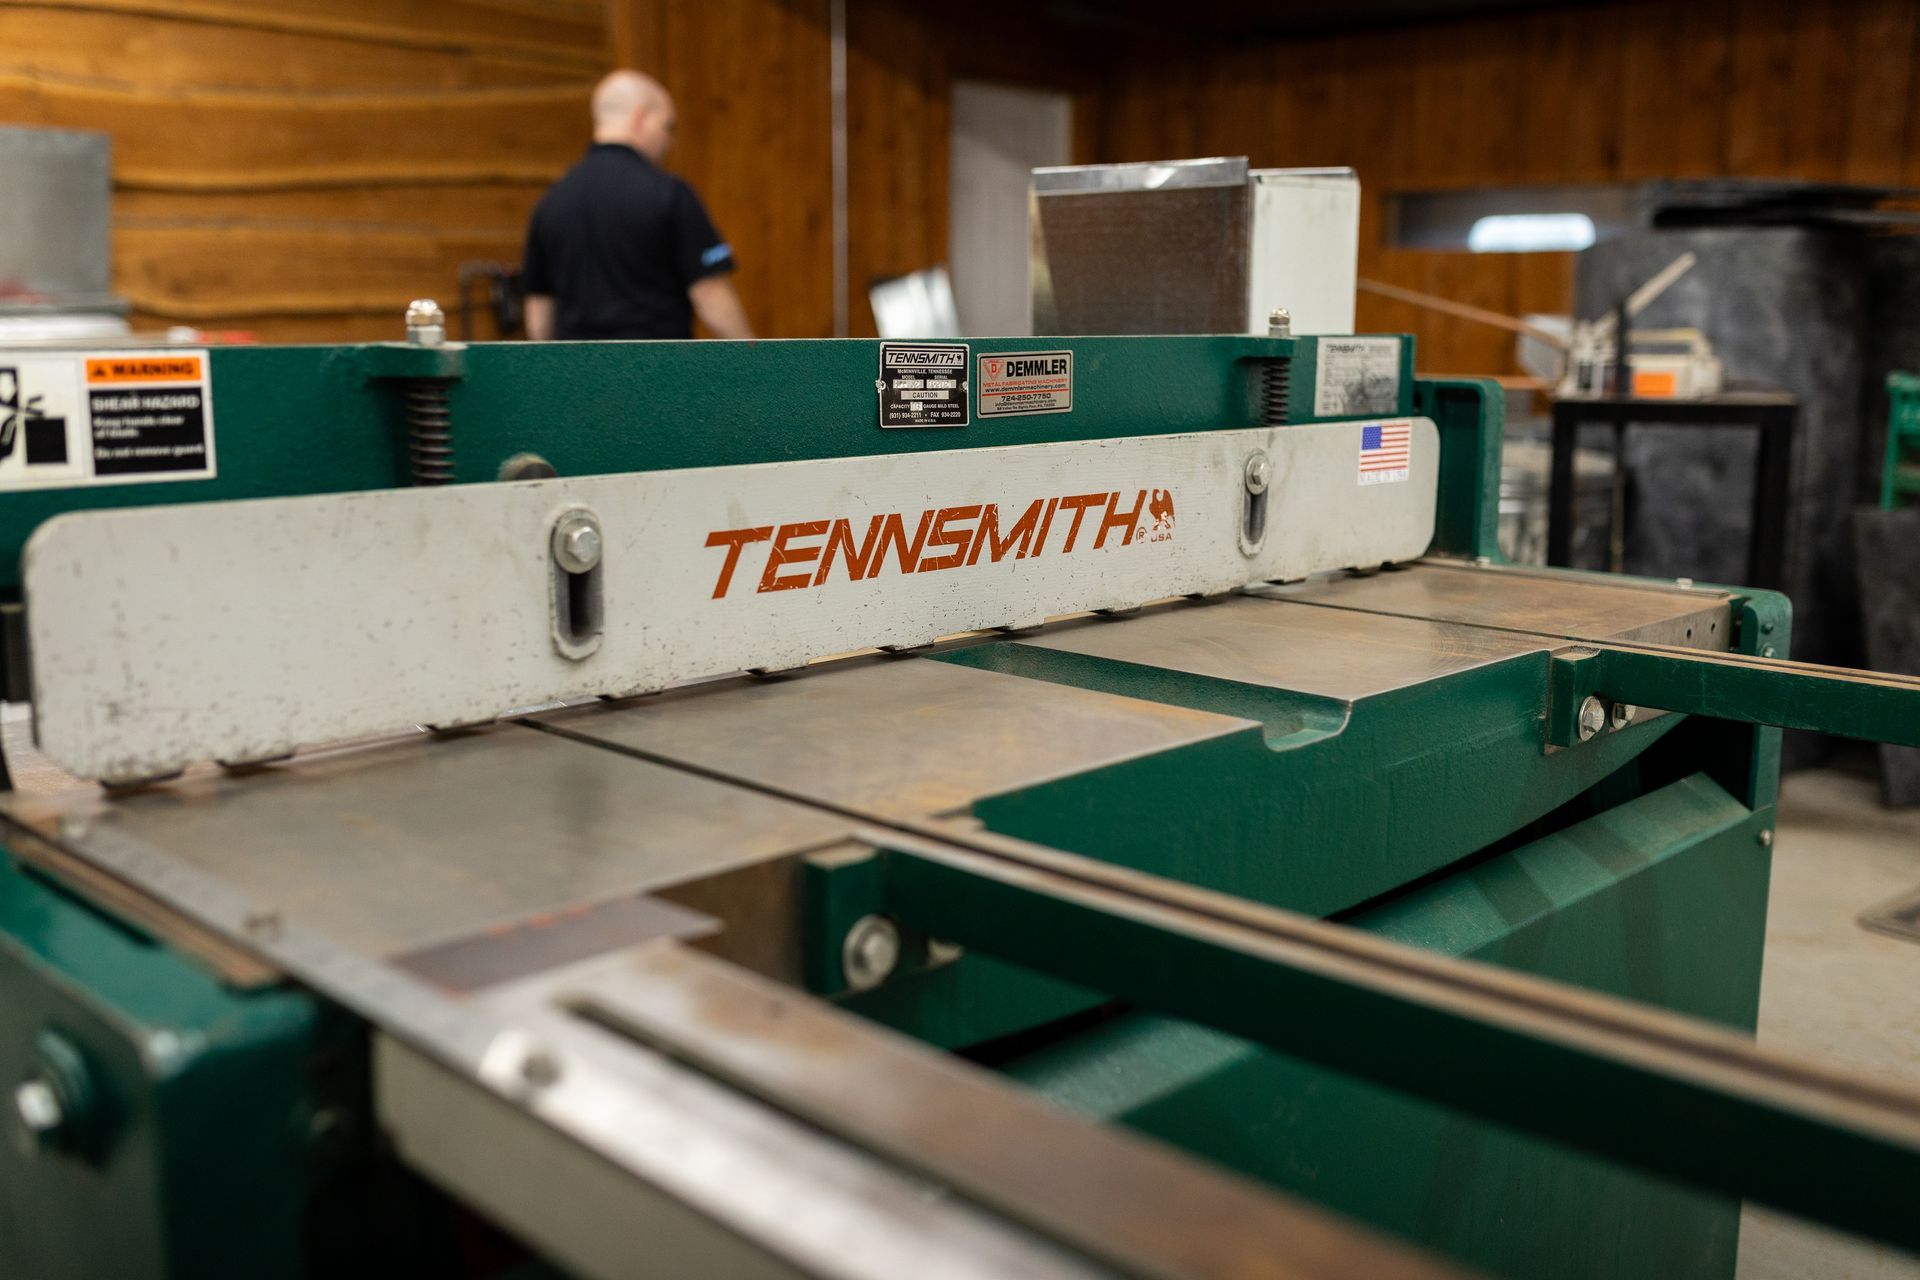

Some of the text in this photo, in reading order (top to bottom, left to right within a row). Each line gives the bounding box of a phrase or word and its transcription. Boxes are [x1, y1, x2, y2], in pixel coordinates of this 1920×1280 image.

[888, 353, 956, 364] TENNSMITH
[113, 362, 194, 376] WARNING
[1006, 359, 1067, 377] DEMMLER
[985, 383, 1066, 393] www.demmlermachinery.com
[1002, 379, 1037, 387] FABRICATING
[92, 395, 200, 411] SHEAR HAZARD
[704, 489, 1147, 599] TENNSMITH
[1151, 533, 1172, 543] USA
